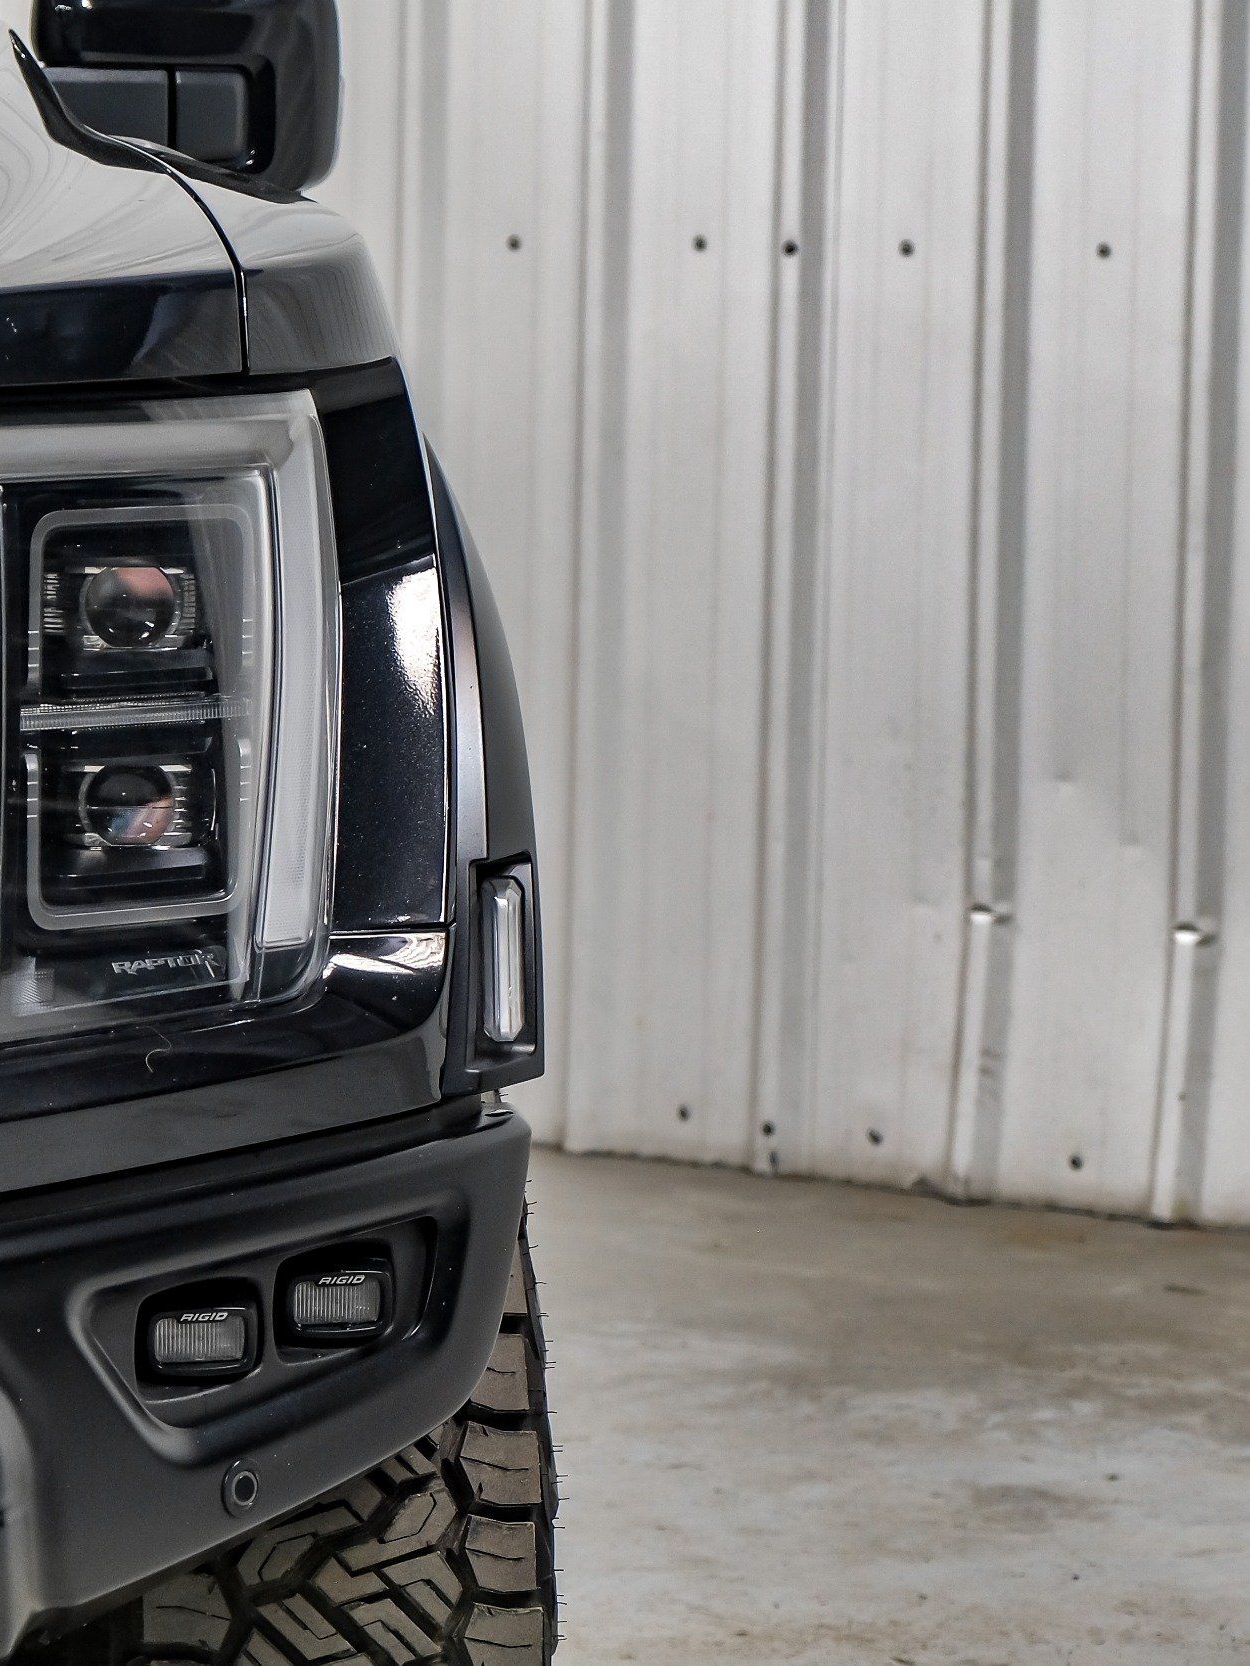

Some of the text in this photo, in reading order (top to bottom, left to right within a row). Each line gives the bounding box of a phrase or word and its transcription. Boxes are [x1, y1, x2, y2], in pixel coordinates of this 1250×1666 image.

[111, 950, 220, 975] RAPTOR
[318, 1274, 365, 1286] RIGID
[180, 1311, 229, 1322] RIGID
